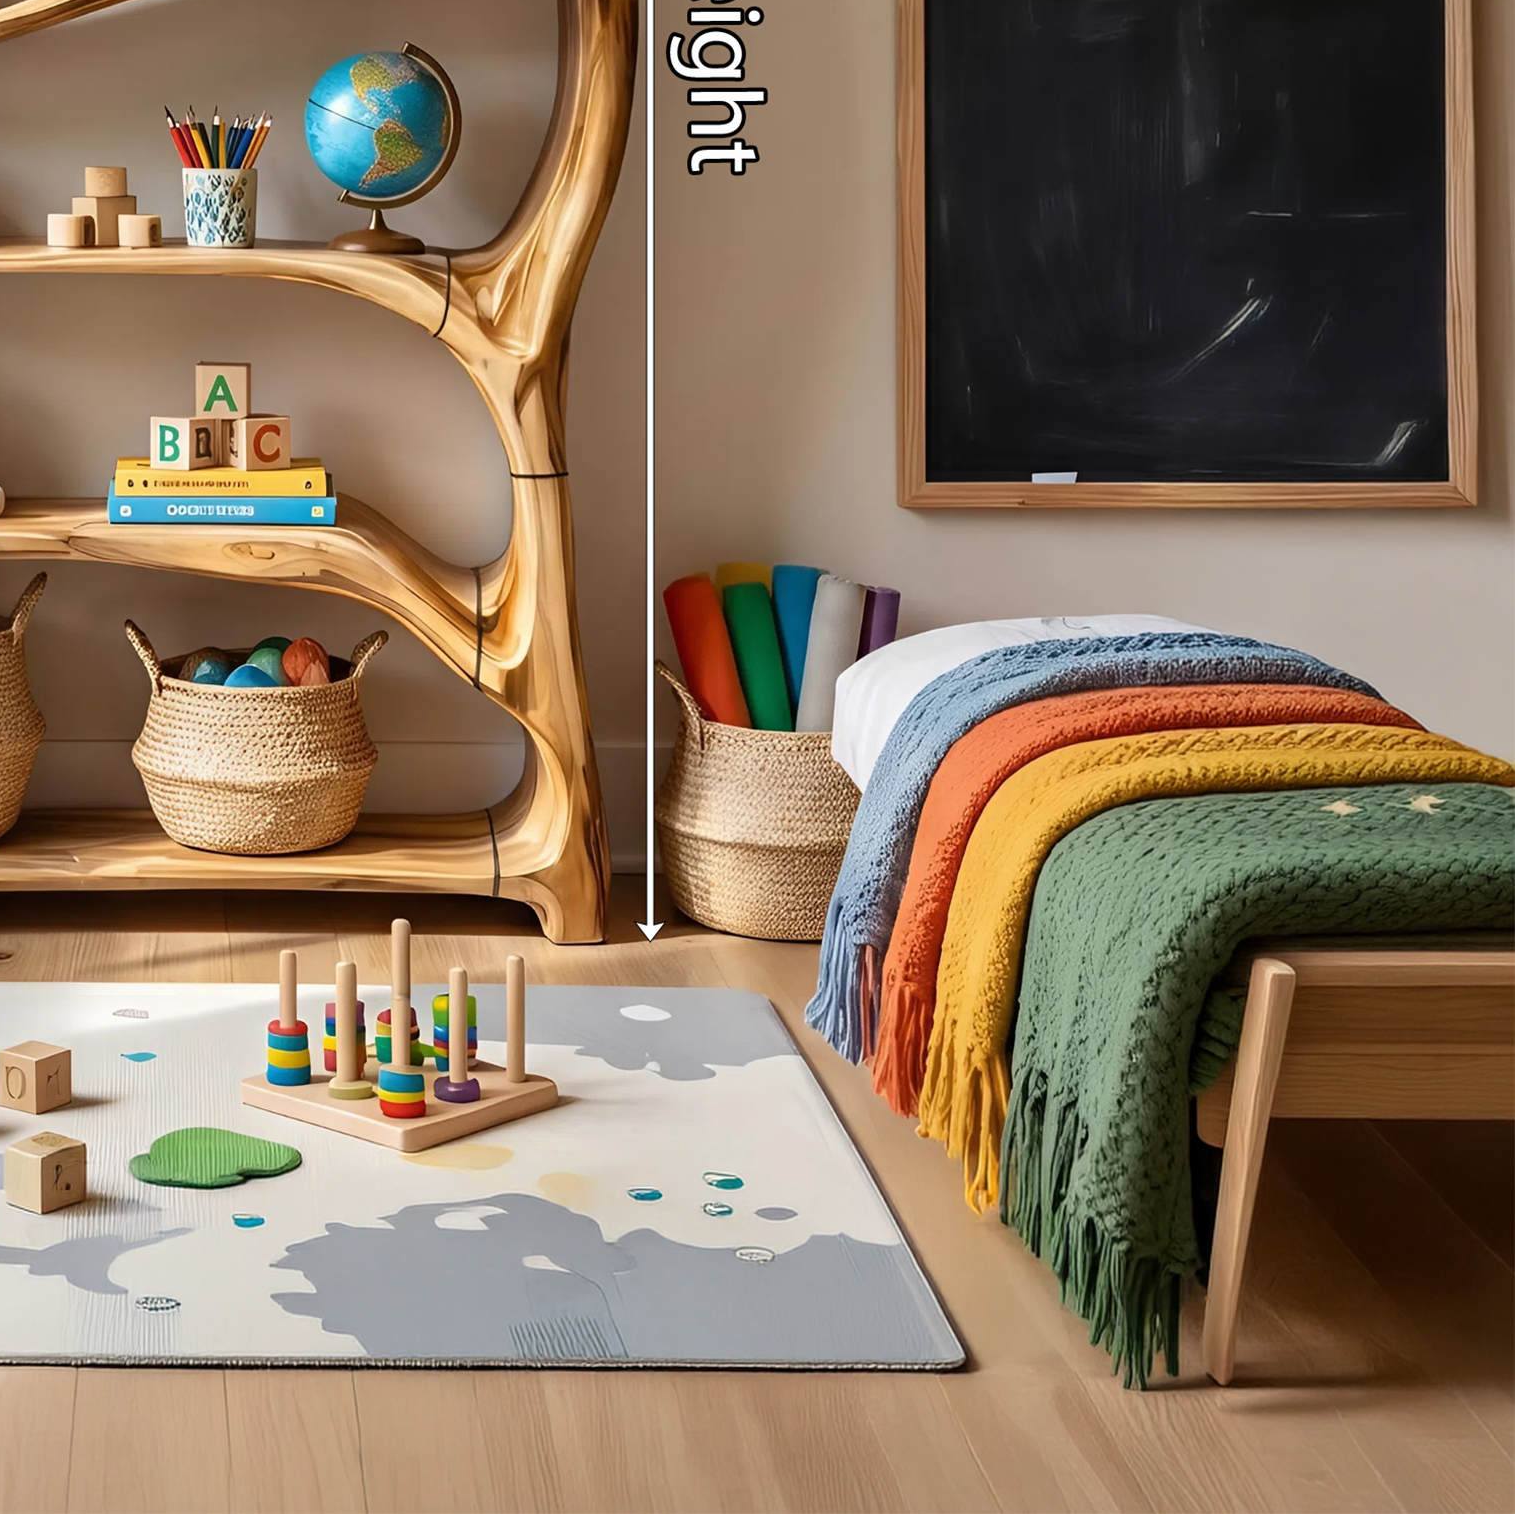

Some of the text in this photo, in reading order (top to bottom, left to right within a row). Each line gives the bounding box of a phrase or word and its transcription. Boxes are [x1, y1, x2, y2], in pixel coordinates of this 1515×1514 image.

[203, 375, 238, 412] A
[159, 424, 180, 462] B
[253, 424, 281, 463] C
